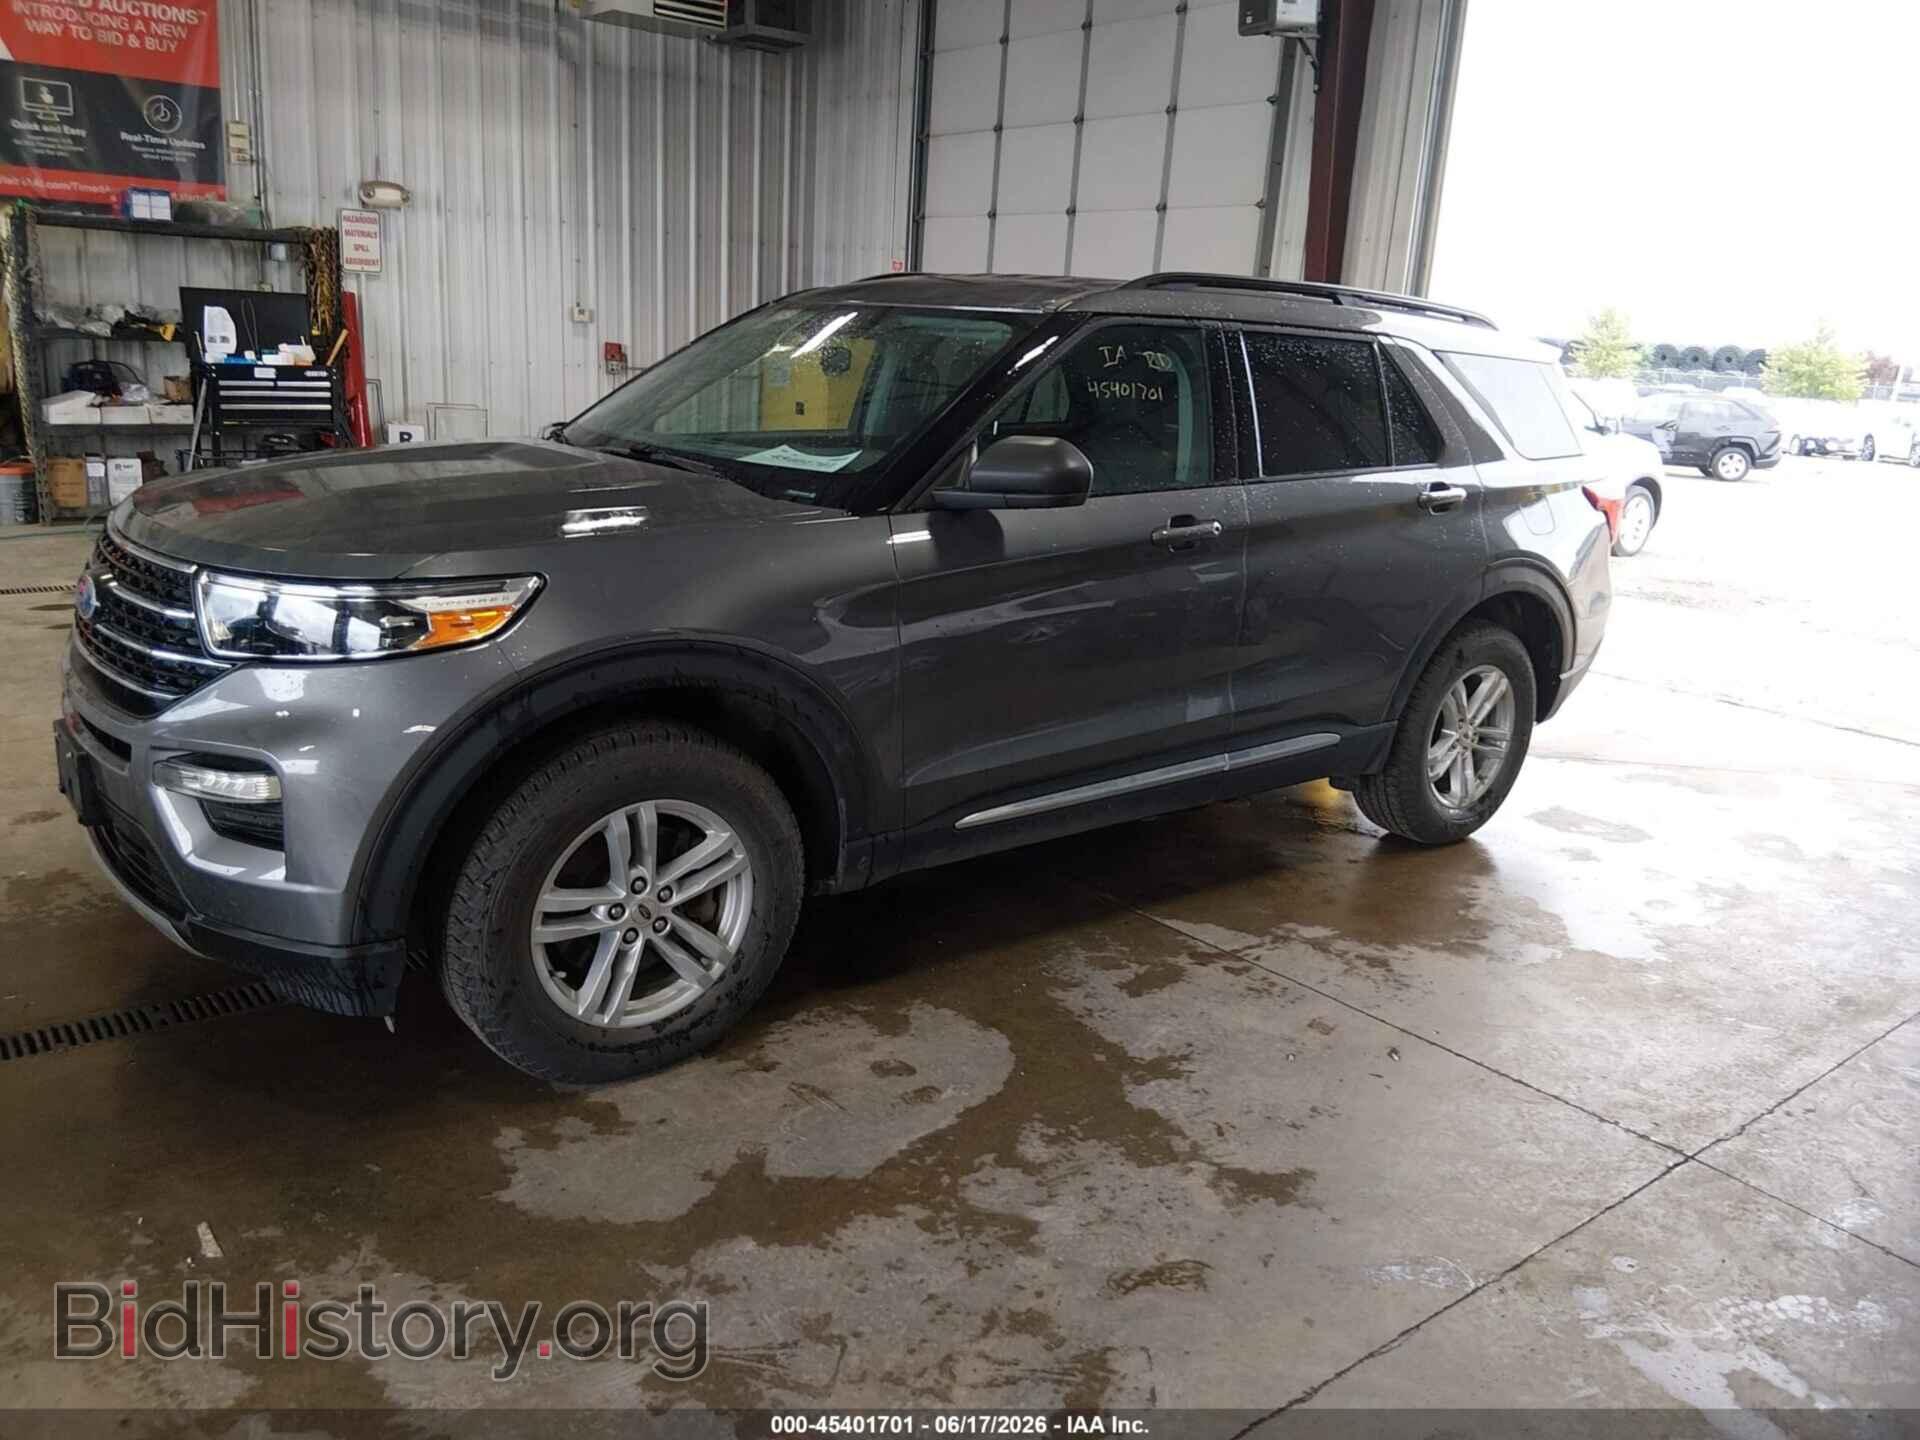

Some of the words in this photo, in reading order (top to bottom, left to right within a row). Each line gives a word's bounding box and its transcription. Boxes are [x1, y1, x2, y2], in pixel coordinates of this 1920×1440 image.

[12, 2, 130, 31] INTRODUCING
[133, 19, 147, 34] A
[149, 22, 188, 39] NEW
[25, 18, 64, 37] WAY
[69, 24, 93, 40] TO
[97, 30, 124, 46] BID
[127, 34, 141, 48] &
[145, 36, 178, 53] BUY
[62, 124, 87, 138] Easy
[120, 131, 168, 145] Real-Time
[168, 137, 206, 149] Updates
[342, 215, 378, 225] HAZARDOUS
[344, 228, 378, 240] MATERIALS
[352, 243, 370, 252] SPILL
[1087, 380, 1163, 400] 45401701
